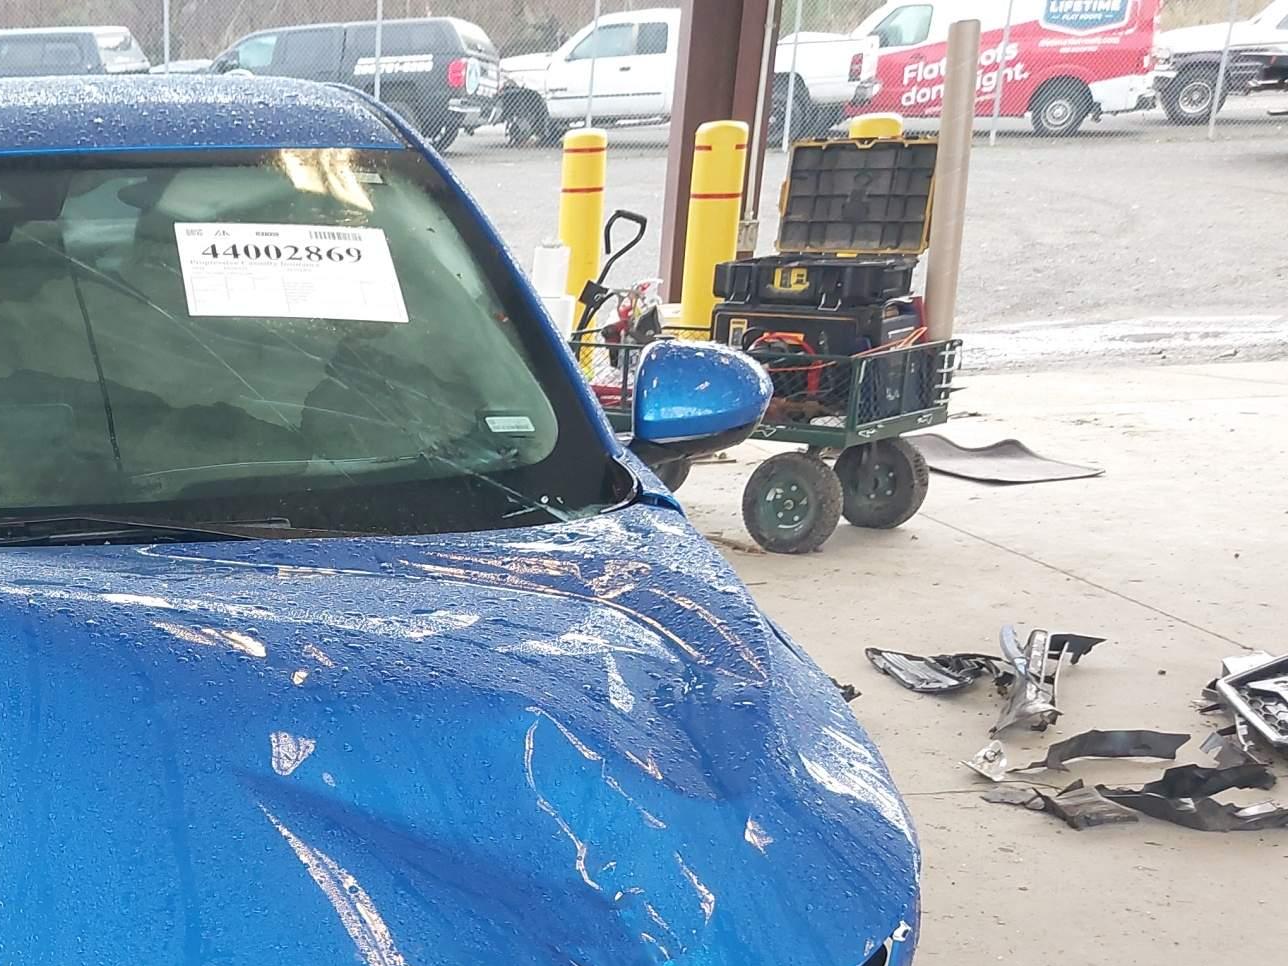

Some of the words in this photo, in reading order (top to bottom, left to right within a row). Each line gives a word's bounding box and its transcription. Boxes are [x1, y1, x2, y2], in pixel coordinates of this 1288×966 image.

[901, 83, 944, 107] don
[975, 62, 1031, 93] ight.
[201, 243, 362, 263] 44002869
